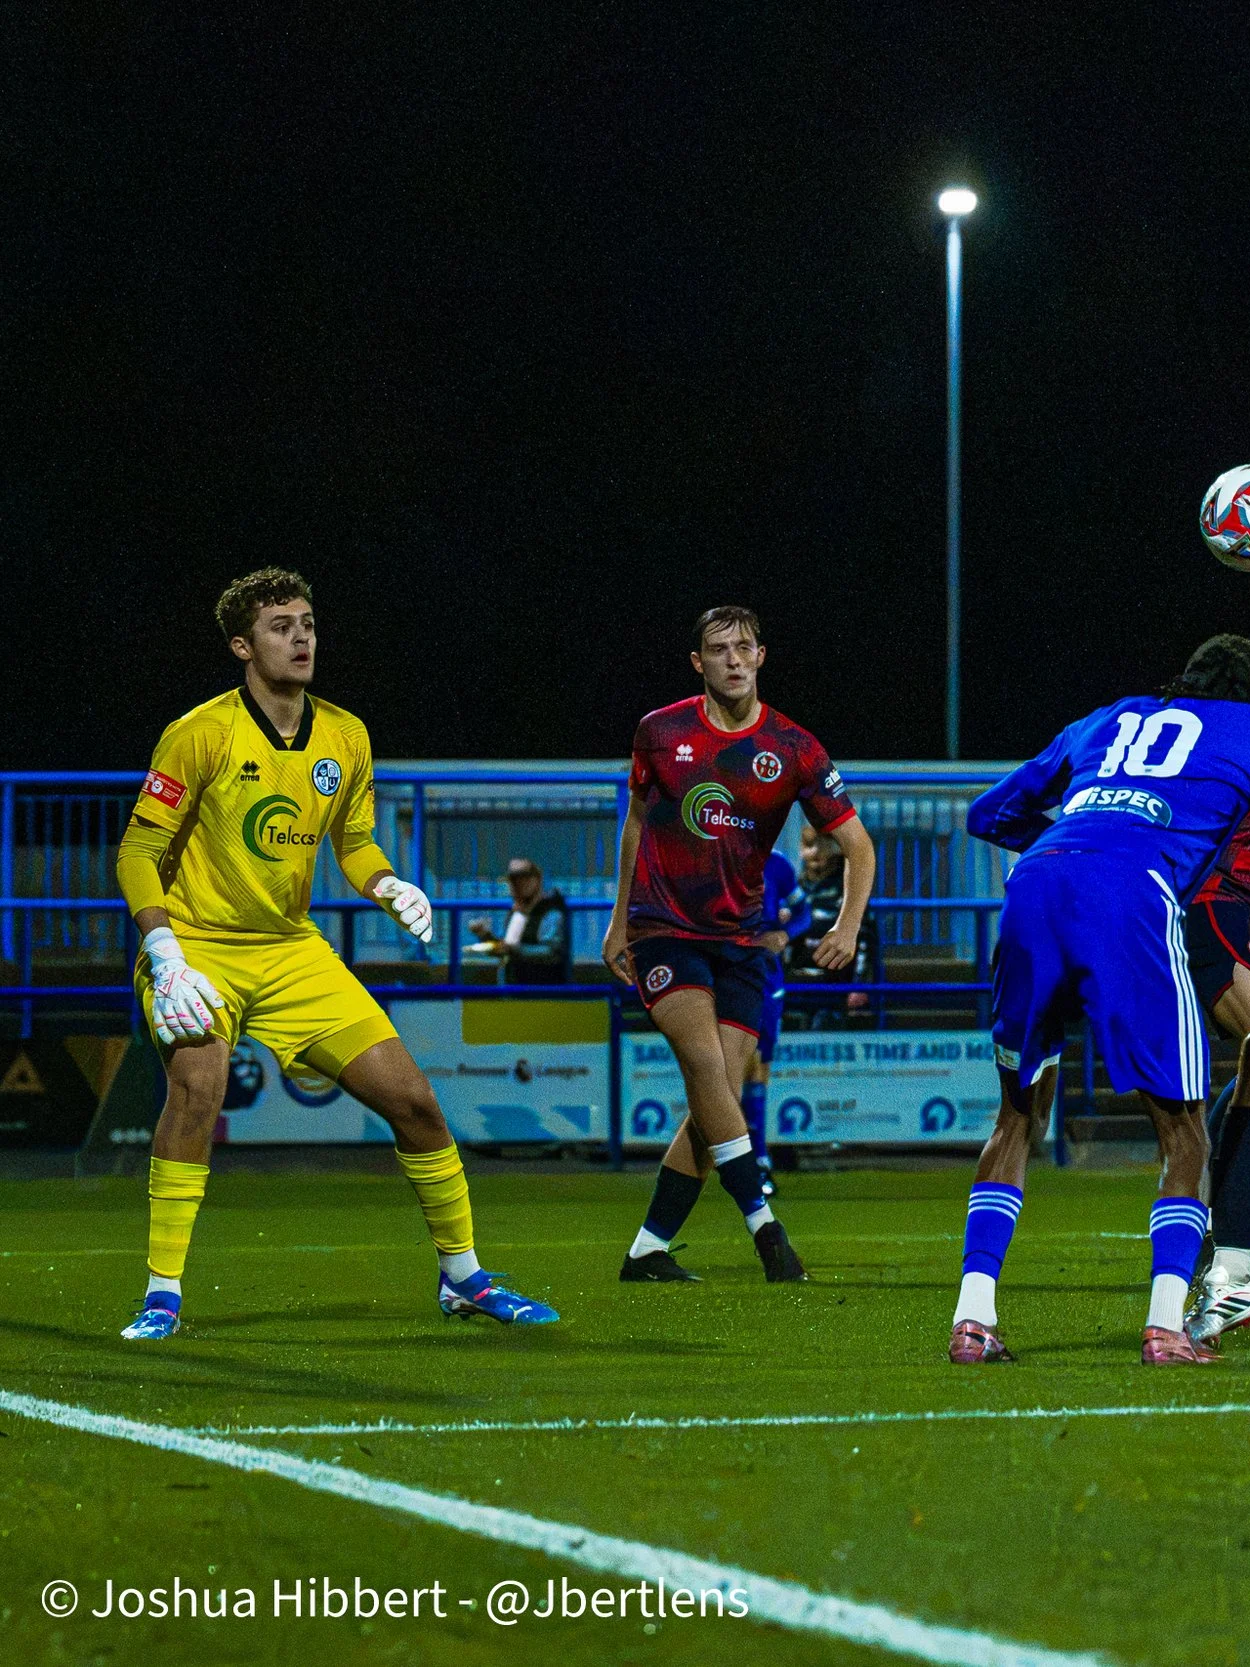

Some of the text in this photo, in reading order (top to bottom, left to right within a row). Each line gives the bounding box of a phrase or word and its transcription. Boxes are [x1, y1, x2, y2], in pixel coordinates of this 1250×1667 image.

[1096, 708, 1204, 778] 10
[702, 808, 755, 830] Telcoss
[863, 1043, 910, 1061] TIME
[915, 1043, 961, 1061] AND
[966, 1042, 995, 1061] MO
